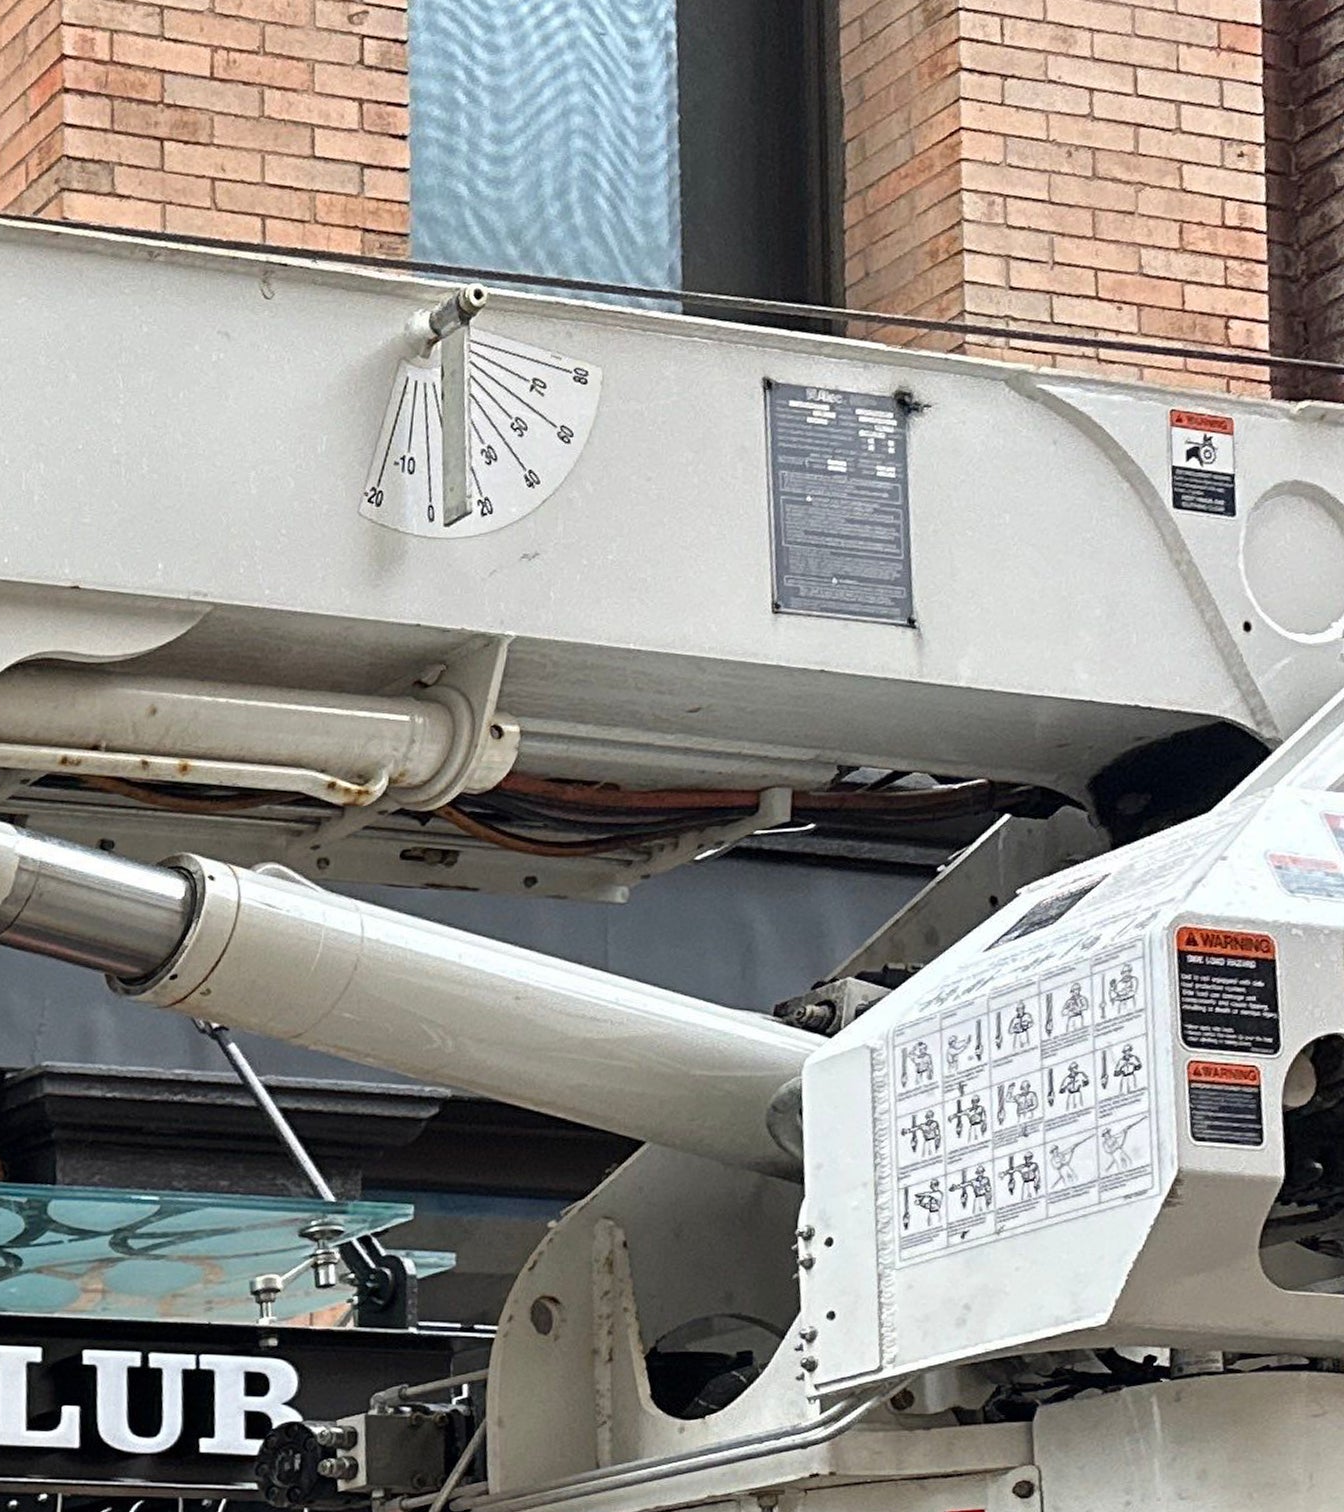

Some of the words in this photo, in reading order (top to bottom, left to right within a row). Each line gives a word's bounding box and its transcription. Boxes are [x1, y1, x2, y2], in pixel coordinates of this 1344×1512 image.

[573, 367, 589, 386] 80
[510, 416, 529, 438] 50
[556, 424, 575, 445] 60
[393, 455, 416, 475] -10
[477, 496, 494, 518] 20
[1200, 932, 1271, 953] WARNING
[1201, 1066, 1257, 1081] WARNING
